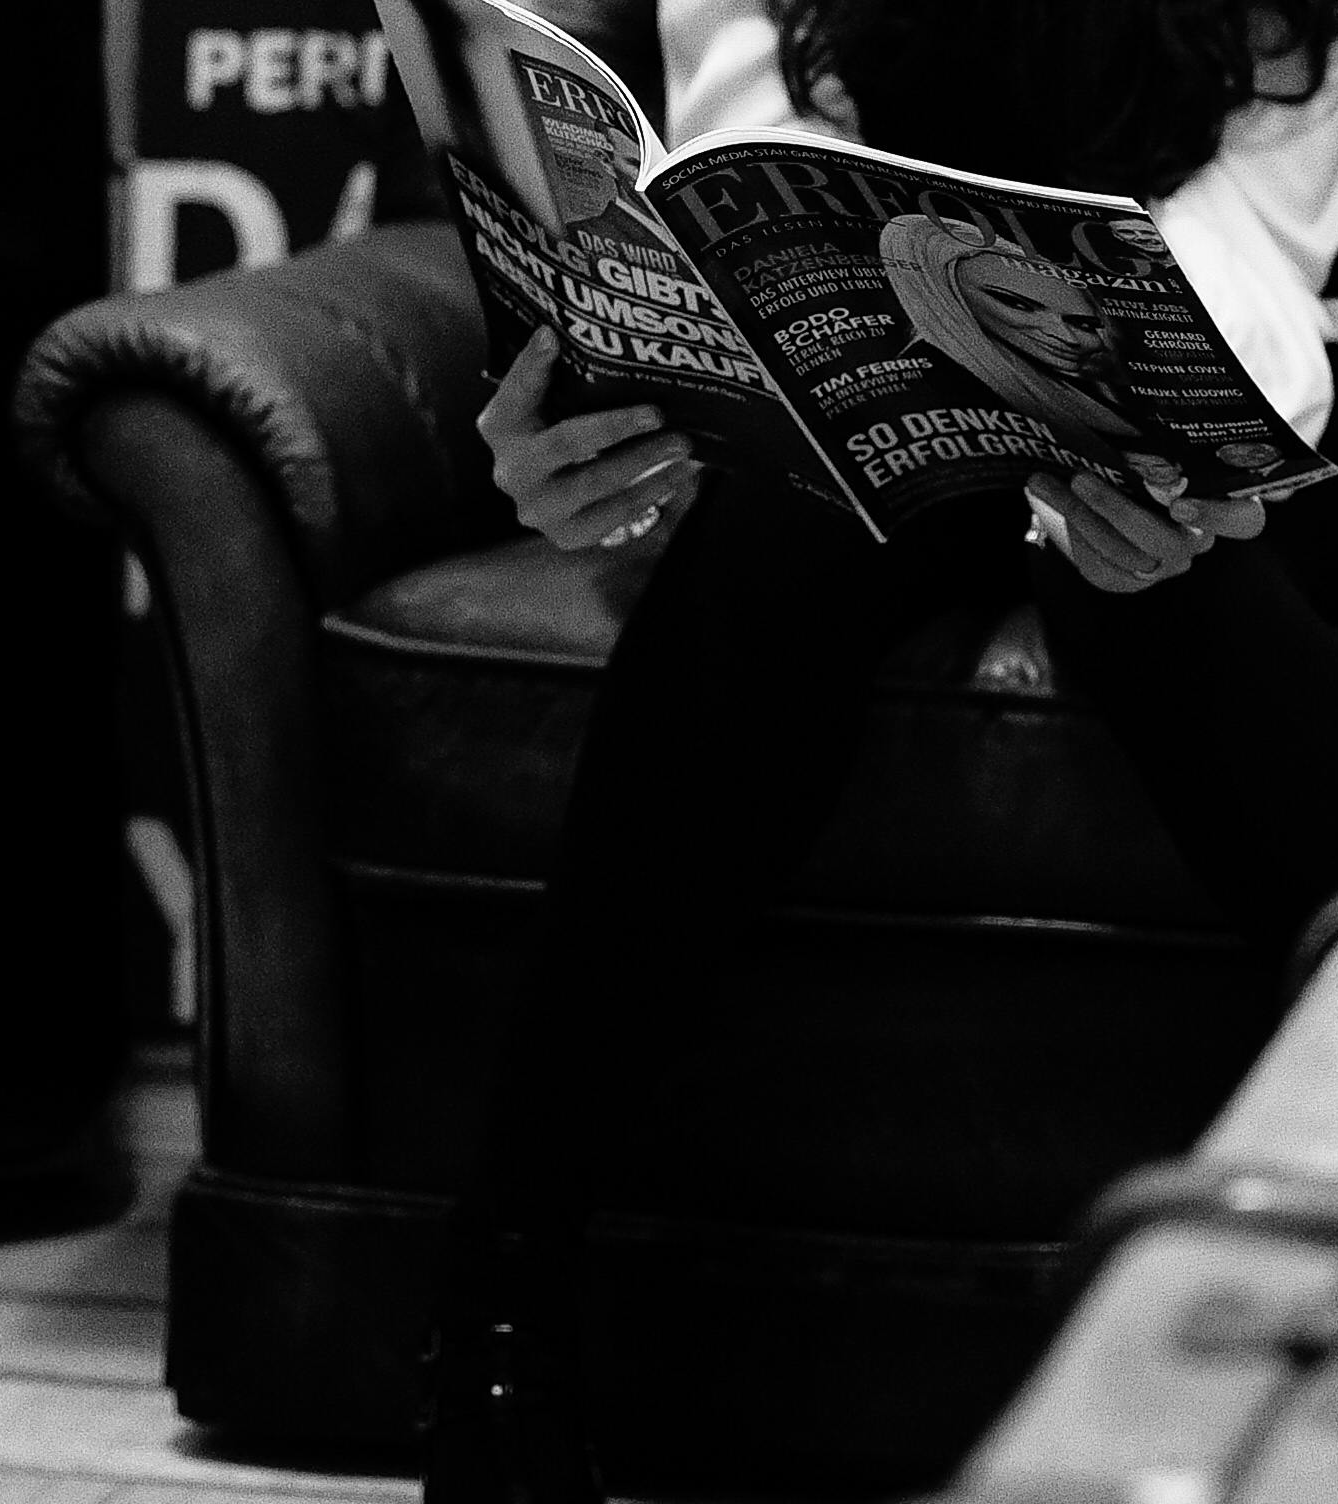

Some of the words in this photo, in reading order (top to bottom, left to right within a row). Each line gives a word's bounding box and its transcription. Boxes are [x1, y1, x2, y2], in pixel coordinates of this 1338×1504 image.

[662, 161, 710, 191] SOCIAL
[708, 149, 751, 170] MEDIA
[754, 147, 788, 158] STAR
[790, 149, 828, 161] GARY
[447, 152, 592, 278] ERFOLG
[665, 160, 1153, 278] ERFOLG
[458, 189, 557, 291] NICHT
[577, 229, 619, 259] DAS
[620, 241, 677, 273] WIRD
[716, 234, 753, 259] DAS
[734, 241, 841, 283] DANIELA
[1003, 256, 1170, 294] magazin
[749, 285, 778, 308] DAS
[777, 266, 850, 294] INTERVIEW
[758, 290, 808, 320] ERFOLG
[807, 280, 838, 299] UND
[840, 277, 885, 292] LEBEN
[1102, 297, 1148, 312] STEVE
[1151, 303, 1190, 315] JOBS
[563, 307, 624, 357] ZU
[773, 306, 851, 345] BODO
[829, 329, 868, 348] REICH
[1143, 338, 1215, 353] SCHRÖDER
[1144, 329, 1207, 343] GERHARD
[795, 348, 844, 377] DENKEN
[809, 370, 855, 400] TIM
[854, 356, 935, 381] FERRIS
[1126, 361, 1187, 376] STEPHEN
[1187, 364, 1228, 376] COVEY
[1181, 388, 1244, 399] LUDOWIG
[846, 421, 900, 464] SO
[899, 407, 1058, 446] DENKEN
[862, 432, 1128, 490] ERFOLGREICHE
